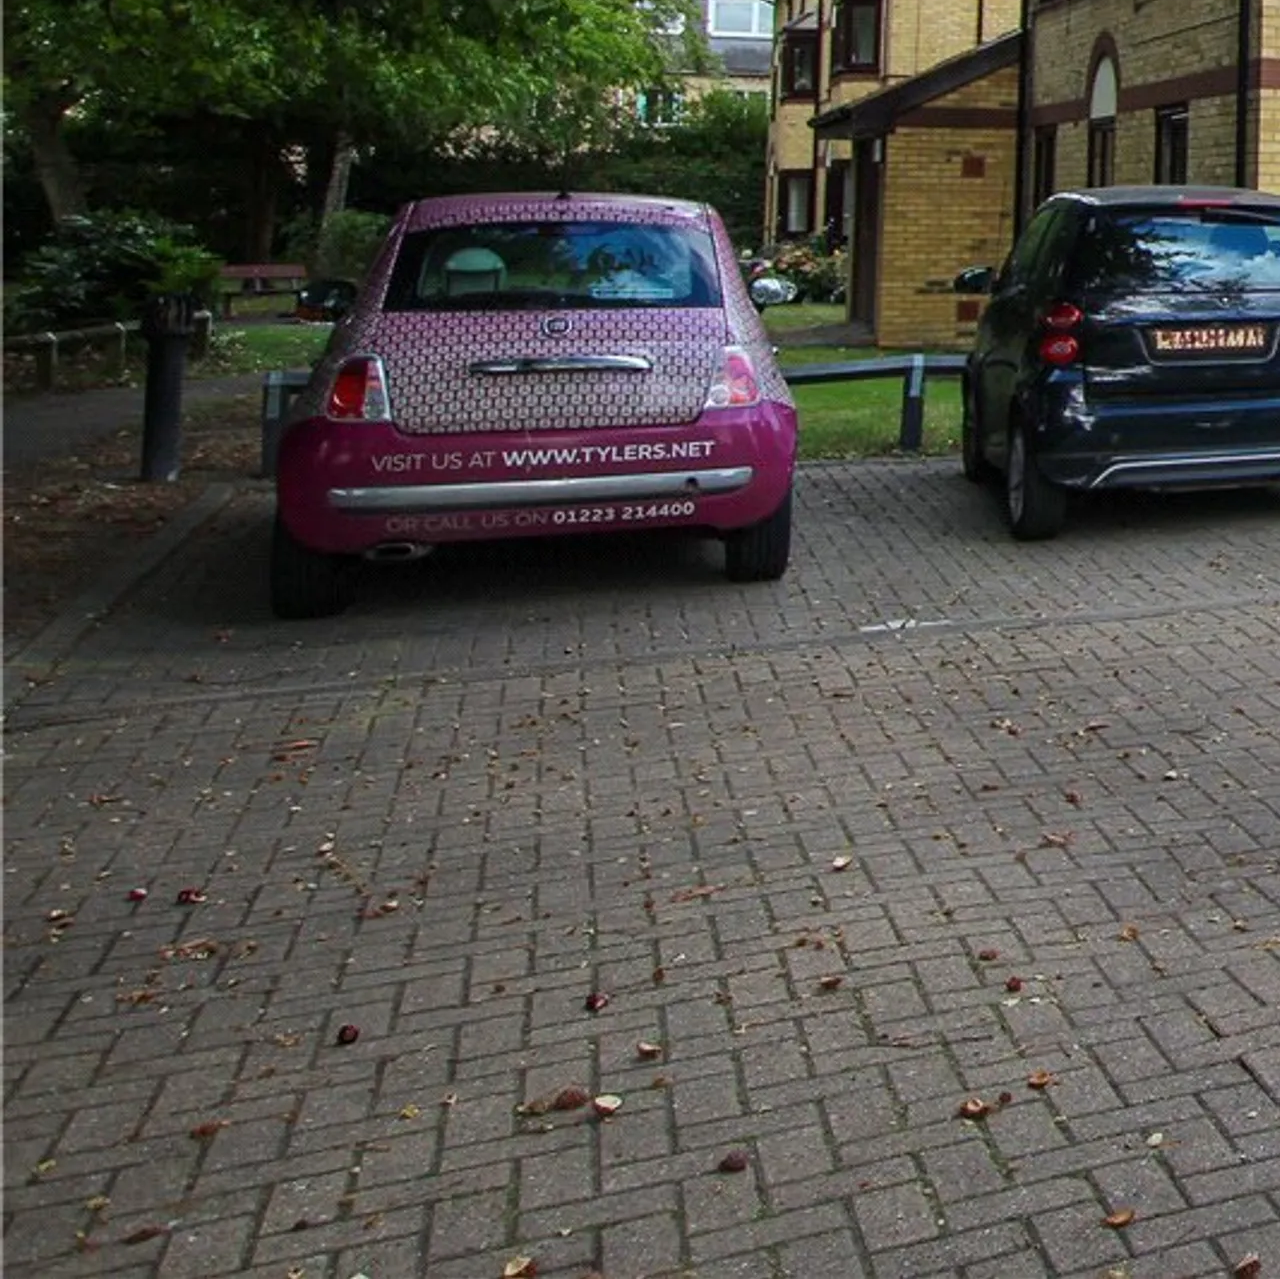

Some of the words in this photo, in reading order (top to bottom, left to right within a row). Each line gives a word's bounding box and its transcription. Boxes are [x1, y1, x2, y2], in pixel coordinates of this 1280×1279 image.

[371, 452, 426, 471] VISIT
[431, 452, 462, 469] US
[468, 451, 497, 468] AT
[502, 440, 716, 467] WWW.TYLERS.NET
[385, 516, 417, 532] OR
[424, 514, 473, 532] CALL
[481, 512, 508, 529] US
[515, 511, 547, 526] ON
[553, 507, 615, 524] 01223
[621, 501, 695, 520] 214400
